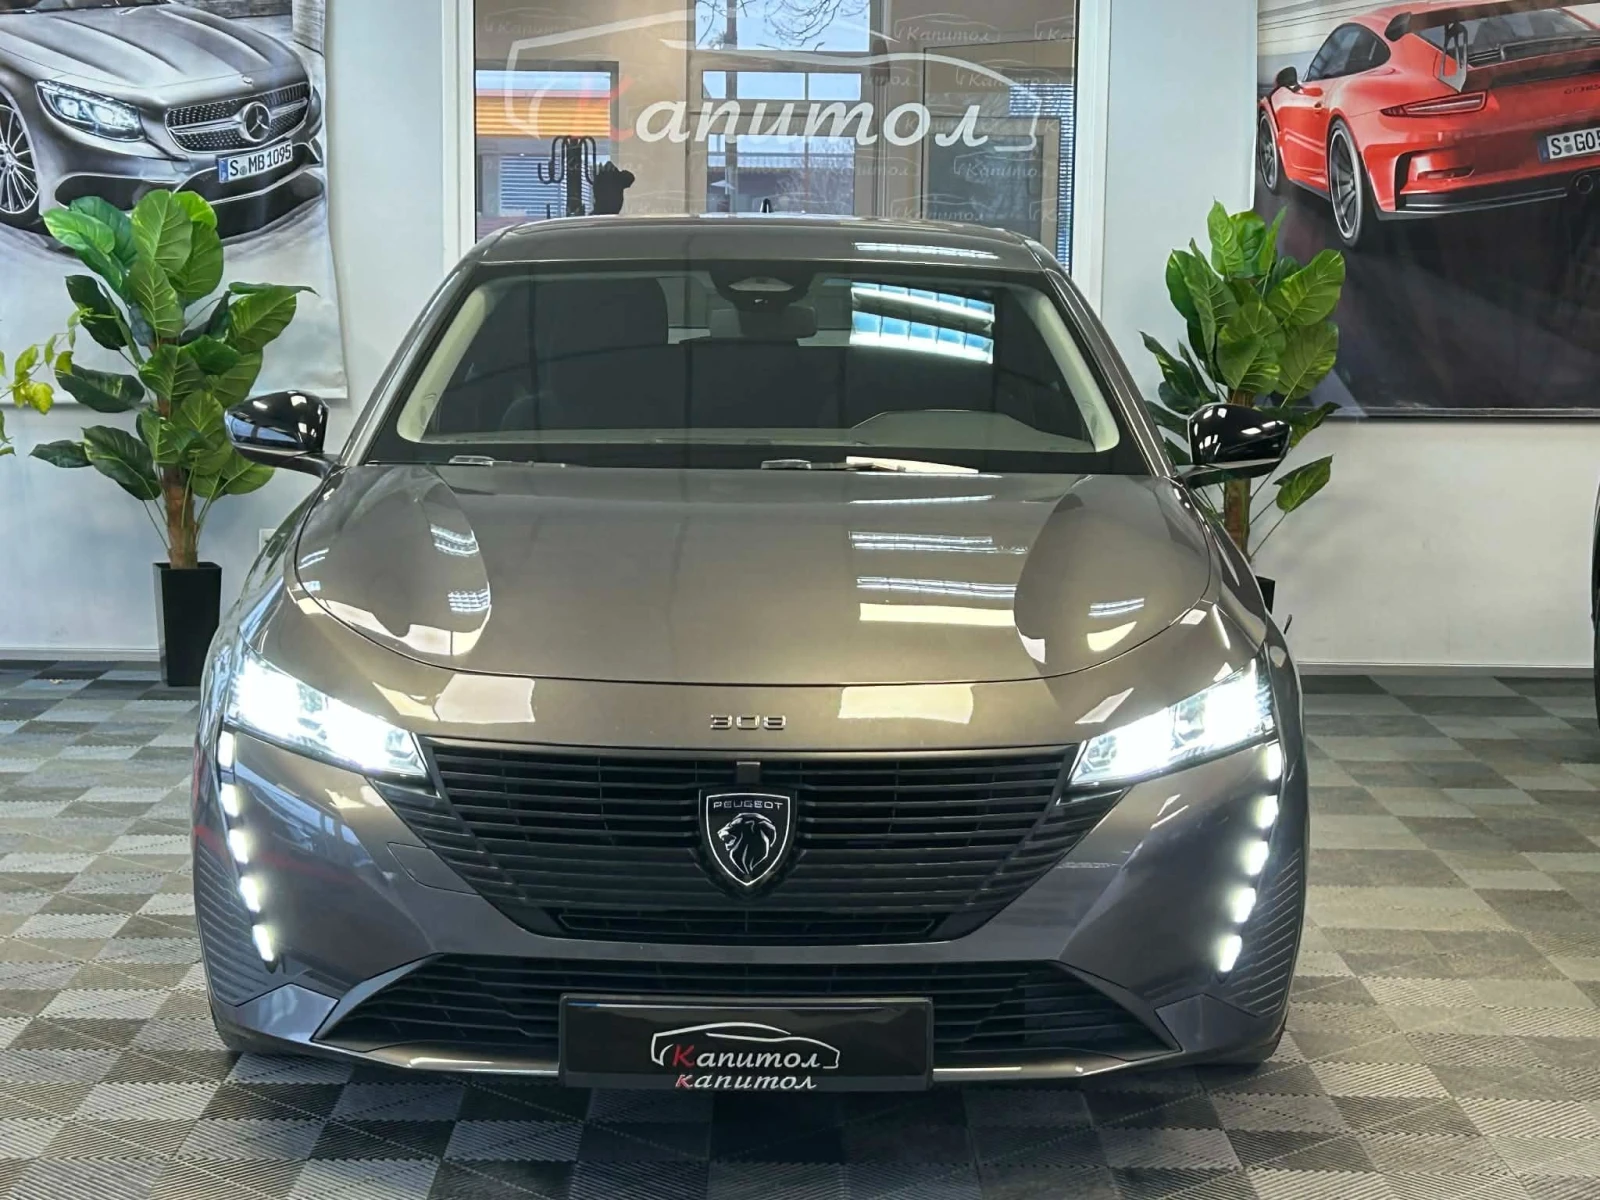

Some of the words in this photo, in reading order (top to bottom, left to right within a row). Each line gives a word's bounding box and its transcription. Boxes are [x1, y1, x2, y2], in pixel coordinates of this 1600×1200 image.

[1551, 138, 1563, 156] S
[229, 160, 239, 176] S
[248, 154, 265, 174] MB
[266, 144, 292, 168] 1095
[710, 714, 787, 731] 308
[713, 801, 784, 811] PEUGEOT
[671, 1044, 821, 1069] Капитол
